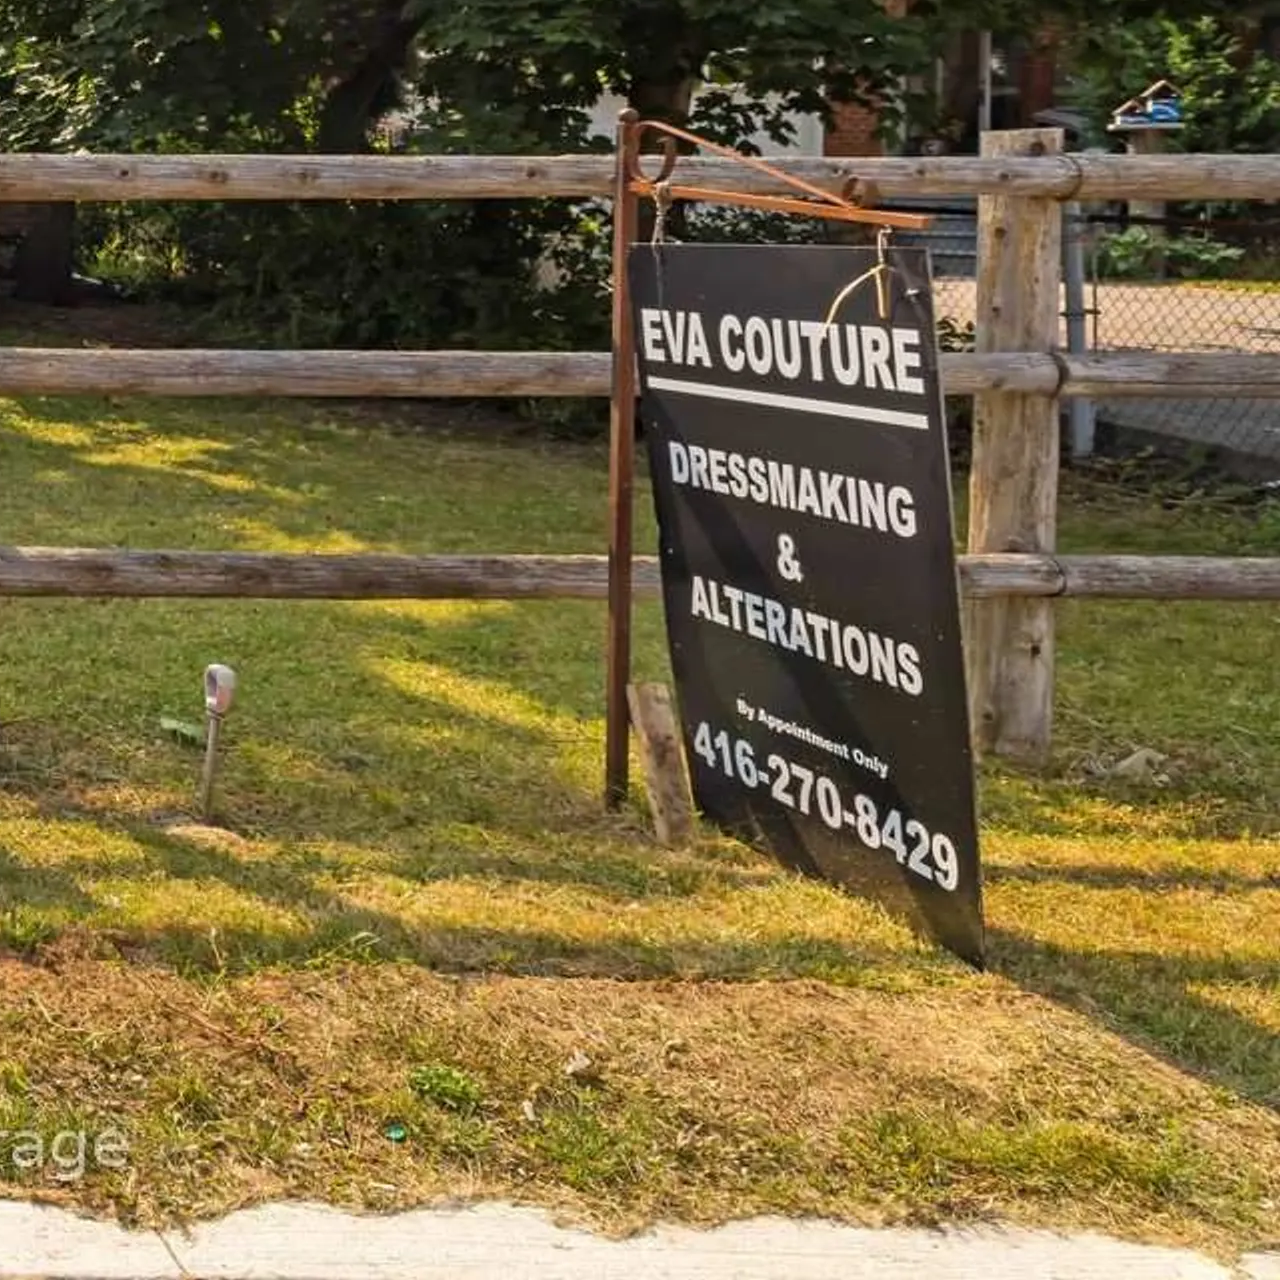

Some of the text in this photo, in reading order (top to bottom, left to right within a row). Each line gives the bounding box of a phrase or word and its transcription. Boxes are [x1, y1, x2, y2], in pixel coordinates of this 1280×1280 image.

[641, 308, 925, 394] EVA COUTURE
[668, 440, 917, 538] DRESSMAKING
[776, 533, 803, 582] &
[691, 575, 923, 696] ALTERATIONS
[736, 698, 889, 780] By Appointment Only
[693, 721, 959, 892] 416-270-8429
